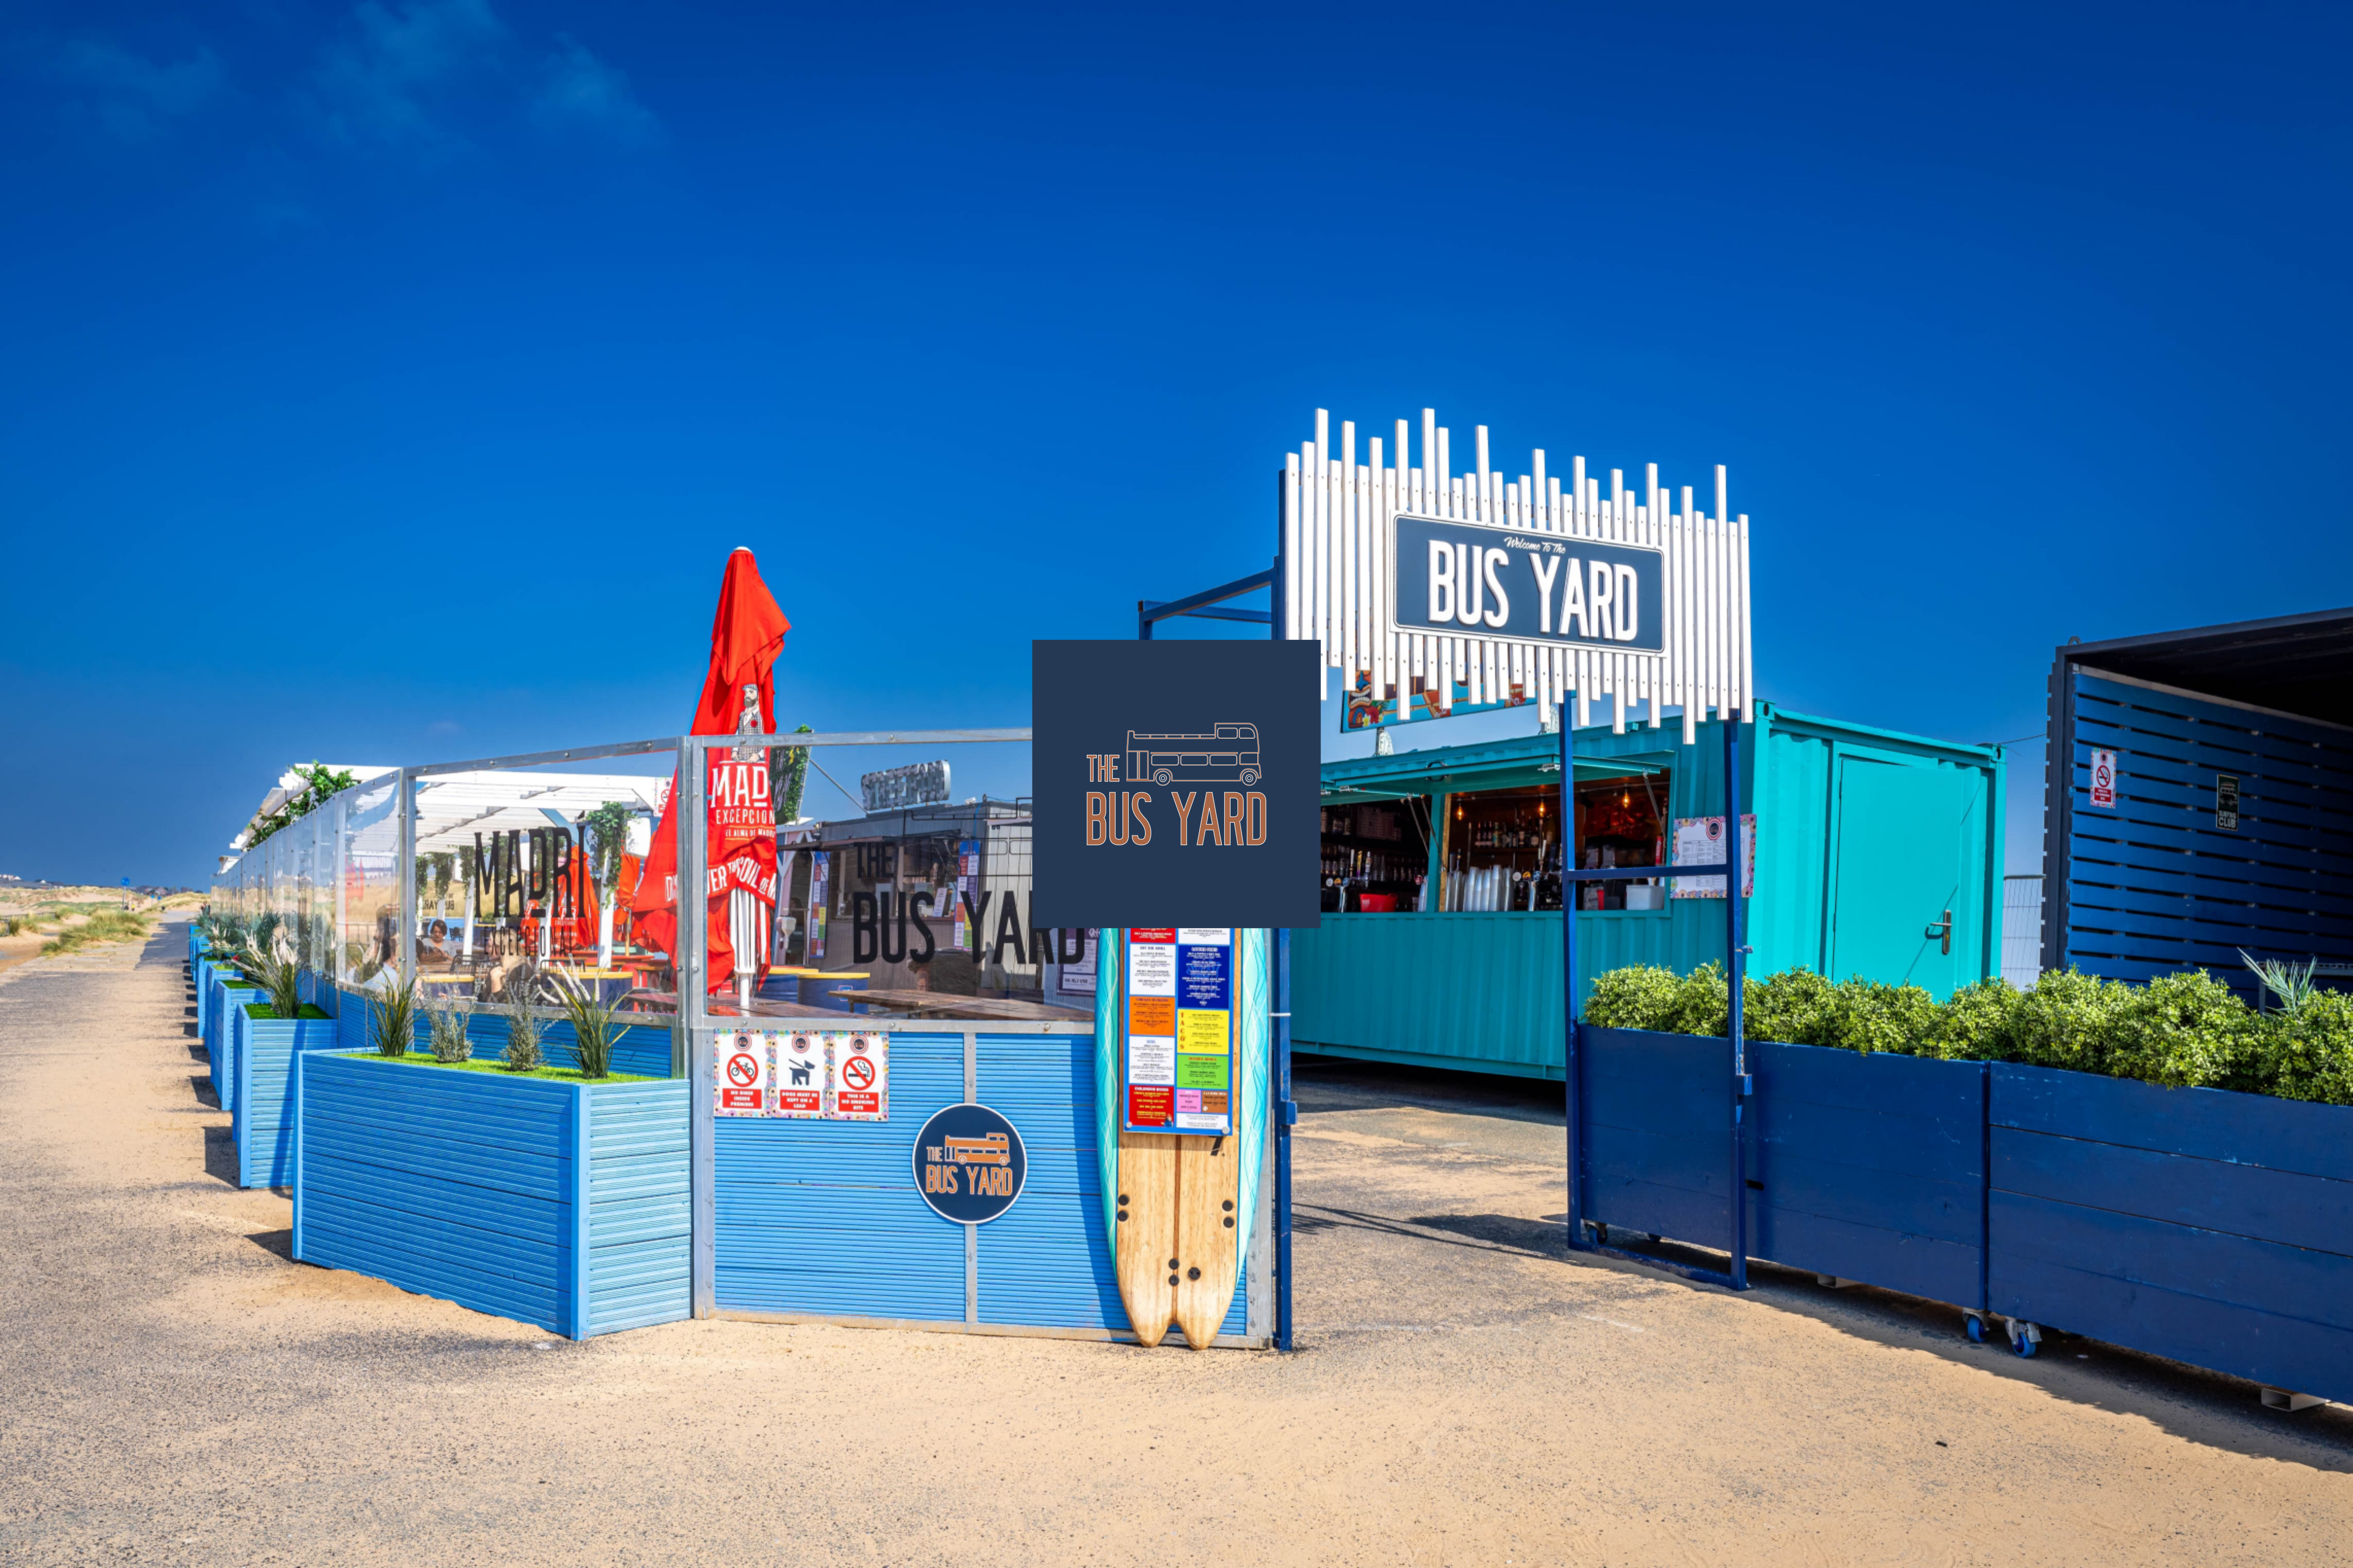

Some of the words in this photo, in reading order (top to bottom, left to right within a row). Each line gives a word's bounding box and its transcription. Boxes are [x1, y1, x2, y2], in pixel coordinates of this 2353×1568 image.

[1503, 536, 1541, 551] Welcome
[1542, 541, 1551, 552] To
[1551, 542, 1566, 554] The
[1428, 539, 1509, 628] BUS
[1529, 552, 1638, 641] YARD
[2219, 817, 2236, 828] CLUB
[853, 842, 894, 878] THE
[484, 926, 573, 957] EXCEPCIONAL
[853, 891, 936, 964] BUS
[926, 1146, 943, 1162] THE
[925, 1164, 958, 1194] BUS
[965, 1165, 1013, 1196] YARD
